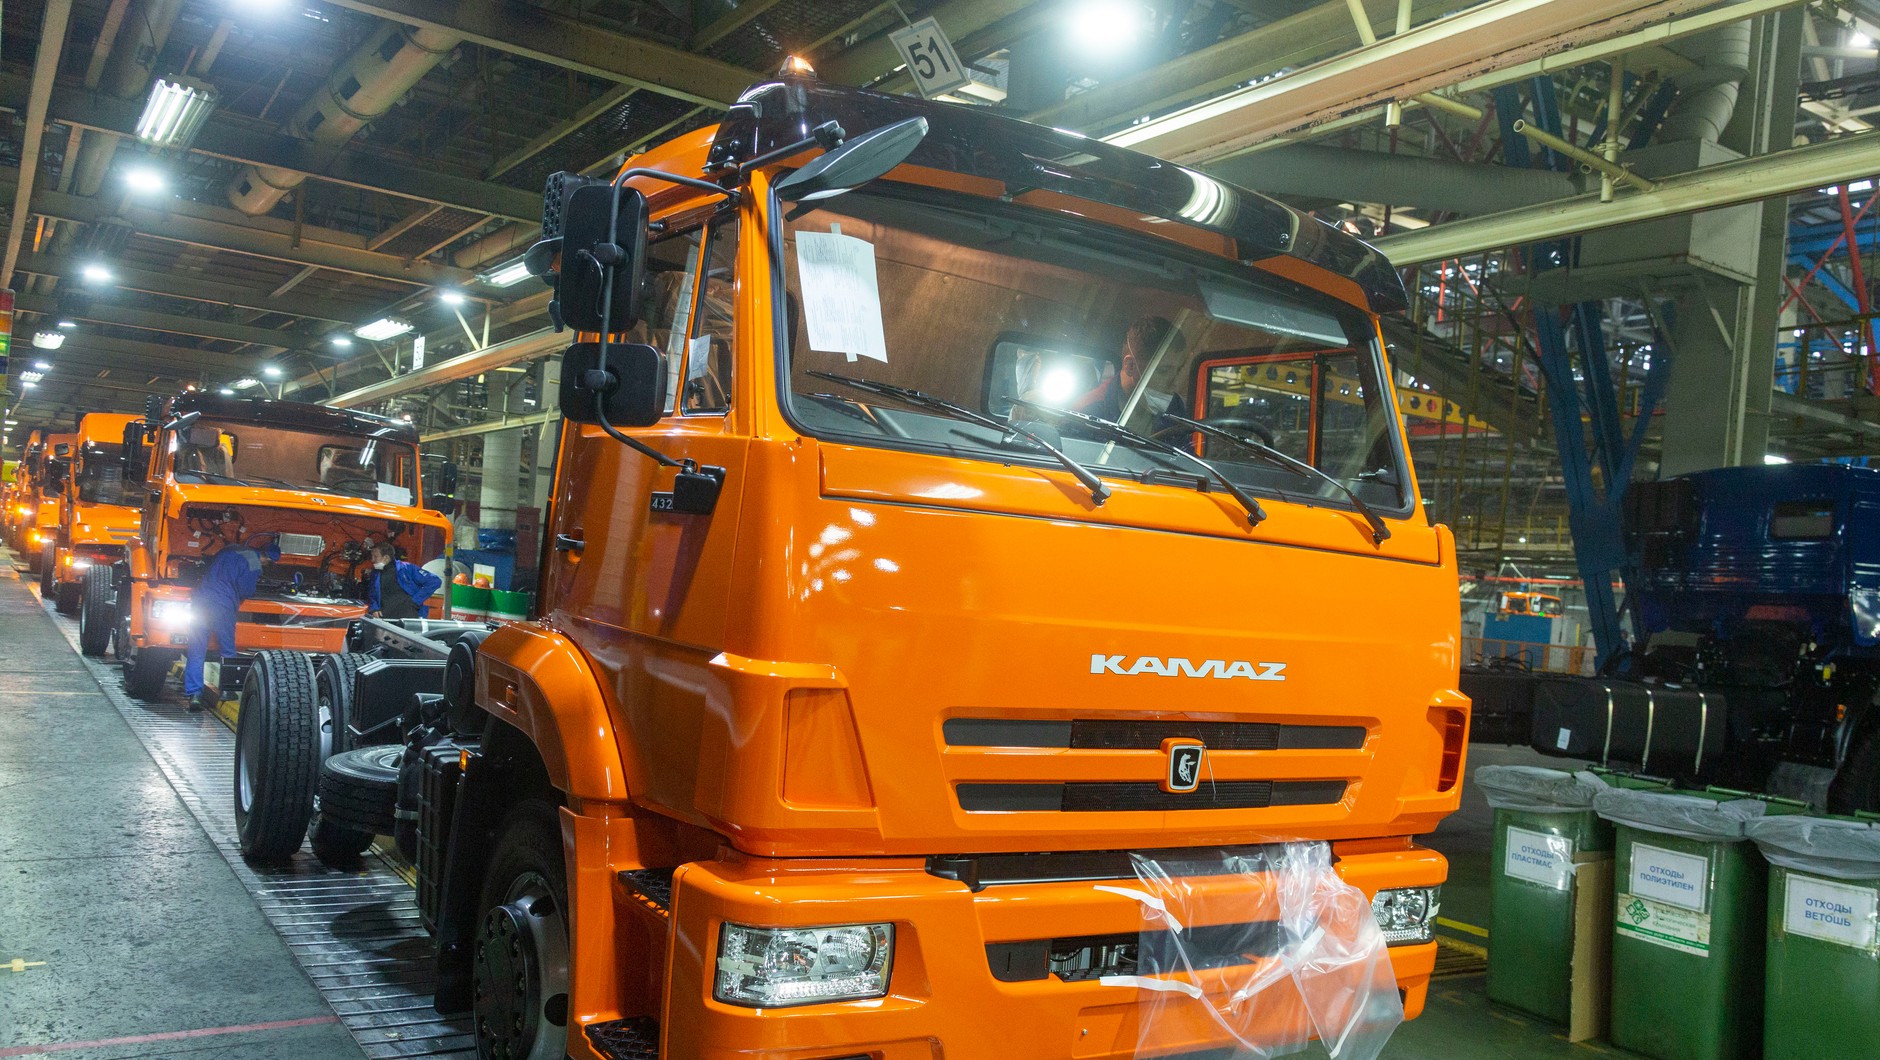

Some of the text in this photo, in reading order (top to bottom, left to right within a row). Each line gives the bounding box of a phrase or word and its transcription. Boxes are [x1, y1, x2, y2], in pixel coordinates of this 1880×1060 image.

[907, 36, 951, 80] 51
[1090, 654, 1287, 681] KAMAZ
[1521, 845, 1555, 859] ОТХОДЫ
[1649, 865, 1685, 880] ОТХОДЫ
[1640, 872, 1694, 892] ПОЛИЭТИЛЕН
[1805, 897, 1852, 914] ОТХОДЫ
[1804, 910, 1852, 927] ВЕТОШЬ
